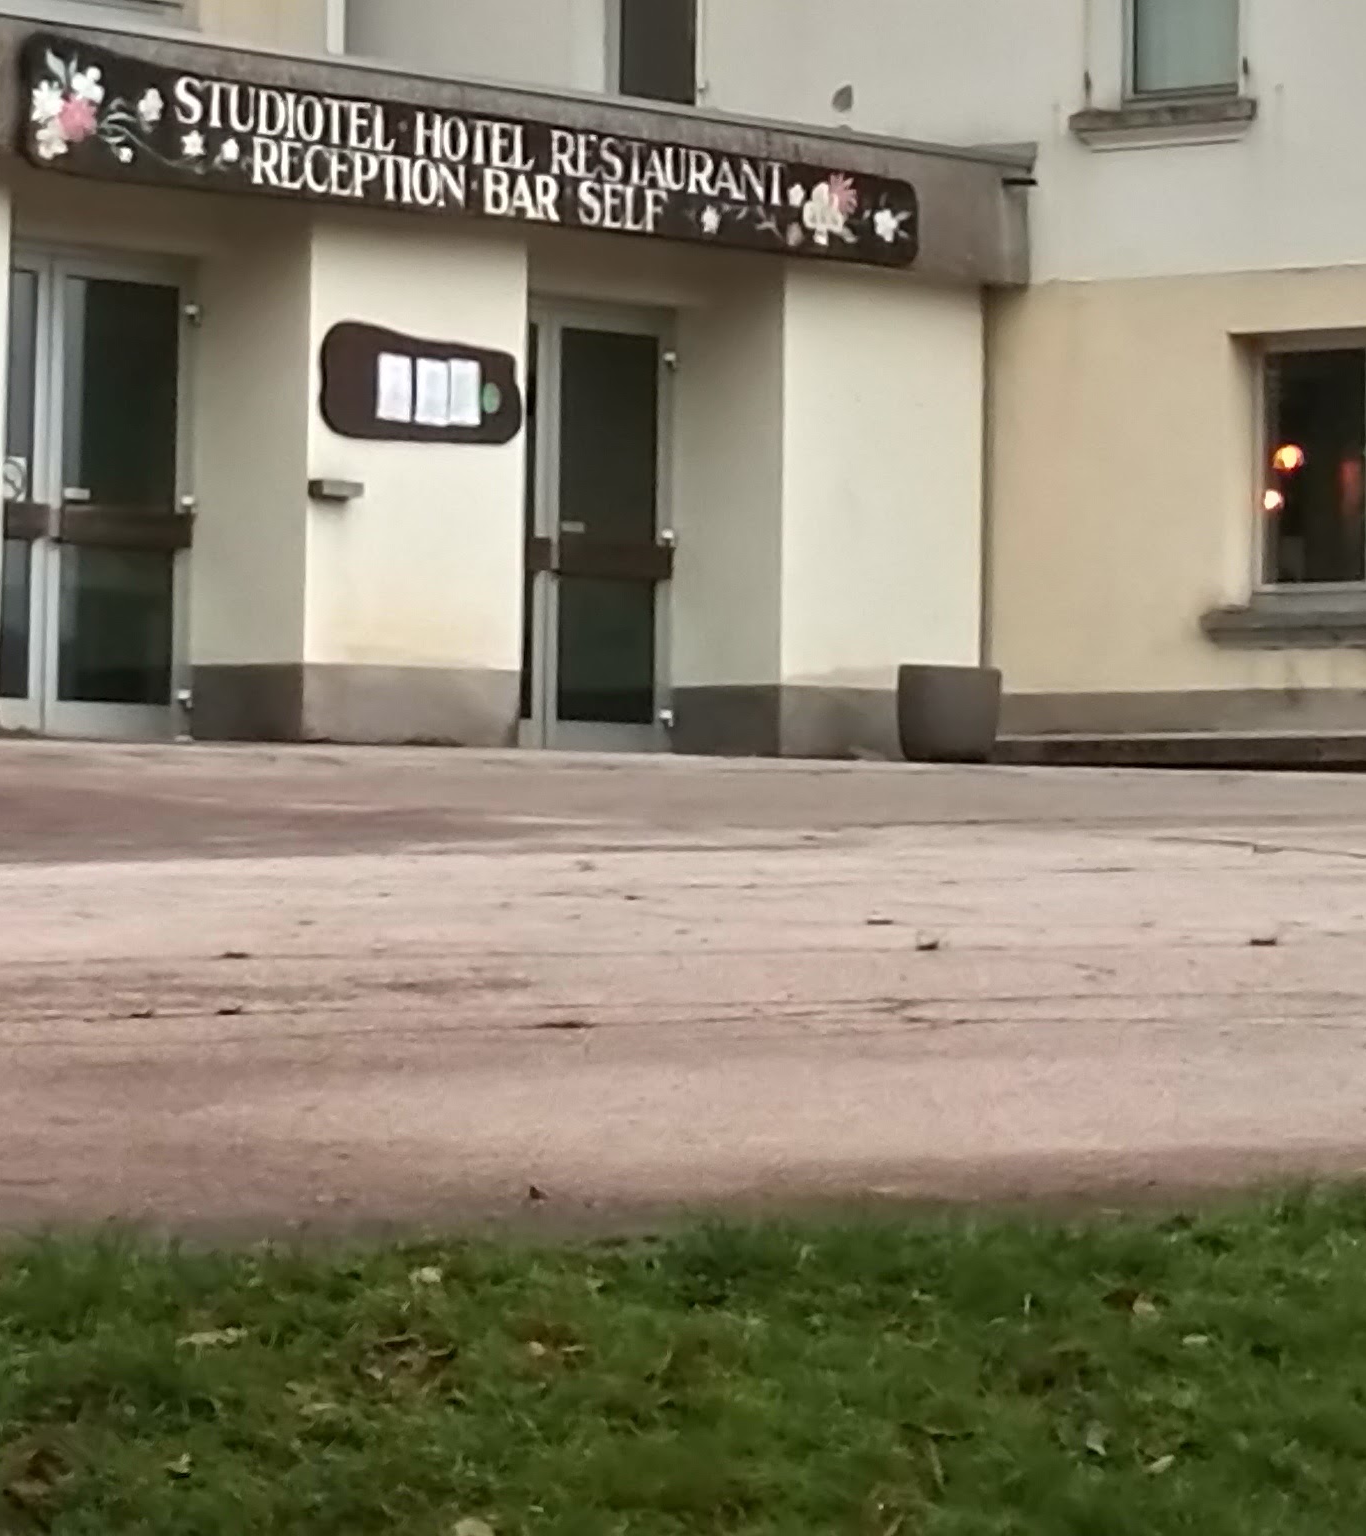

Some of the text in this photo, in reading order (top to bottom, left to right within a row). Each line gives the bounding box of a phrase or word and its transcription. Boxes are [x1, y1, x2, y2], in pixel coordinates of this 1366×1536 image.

[174, 76, 785, 206] STUDIOTEL HOTEL RESTAURANT
[251, 138, 668, 233] RECEPTION BAR SELF
